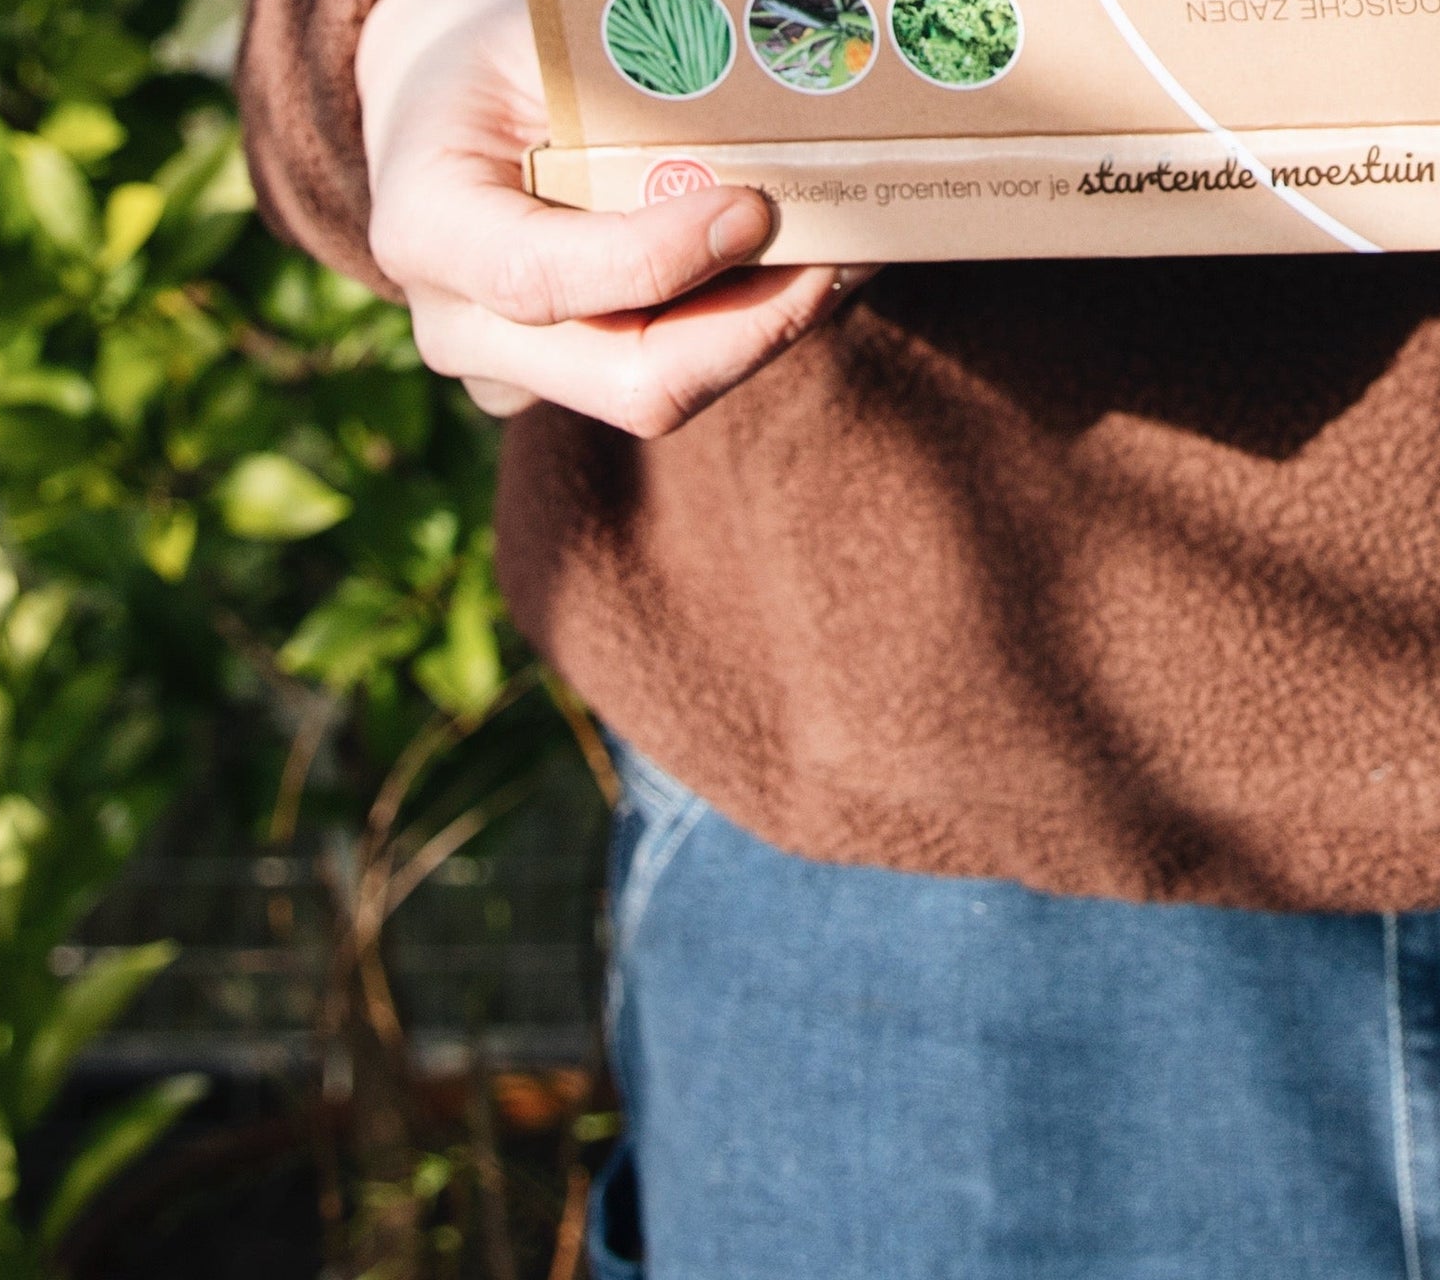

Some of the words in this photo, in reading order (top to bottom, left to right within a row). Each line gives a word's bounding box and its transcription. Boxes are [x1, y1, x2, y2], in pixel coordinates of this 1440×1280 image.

[750, 180, 867, 206] akkelijke
[875, 179, 983, 206] groenten
[987, 177, 1040, 197] voor
[1049, 174, 1070, 200] je
[1077, 151, 1257, 195] startende
[1270, 145, 1436, 188] moestuin
